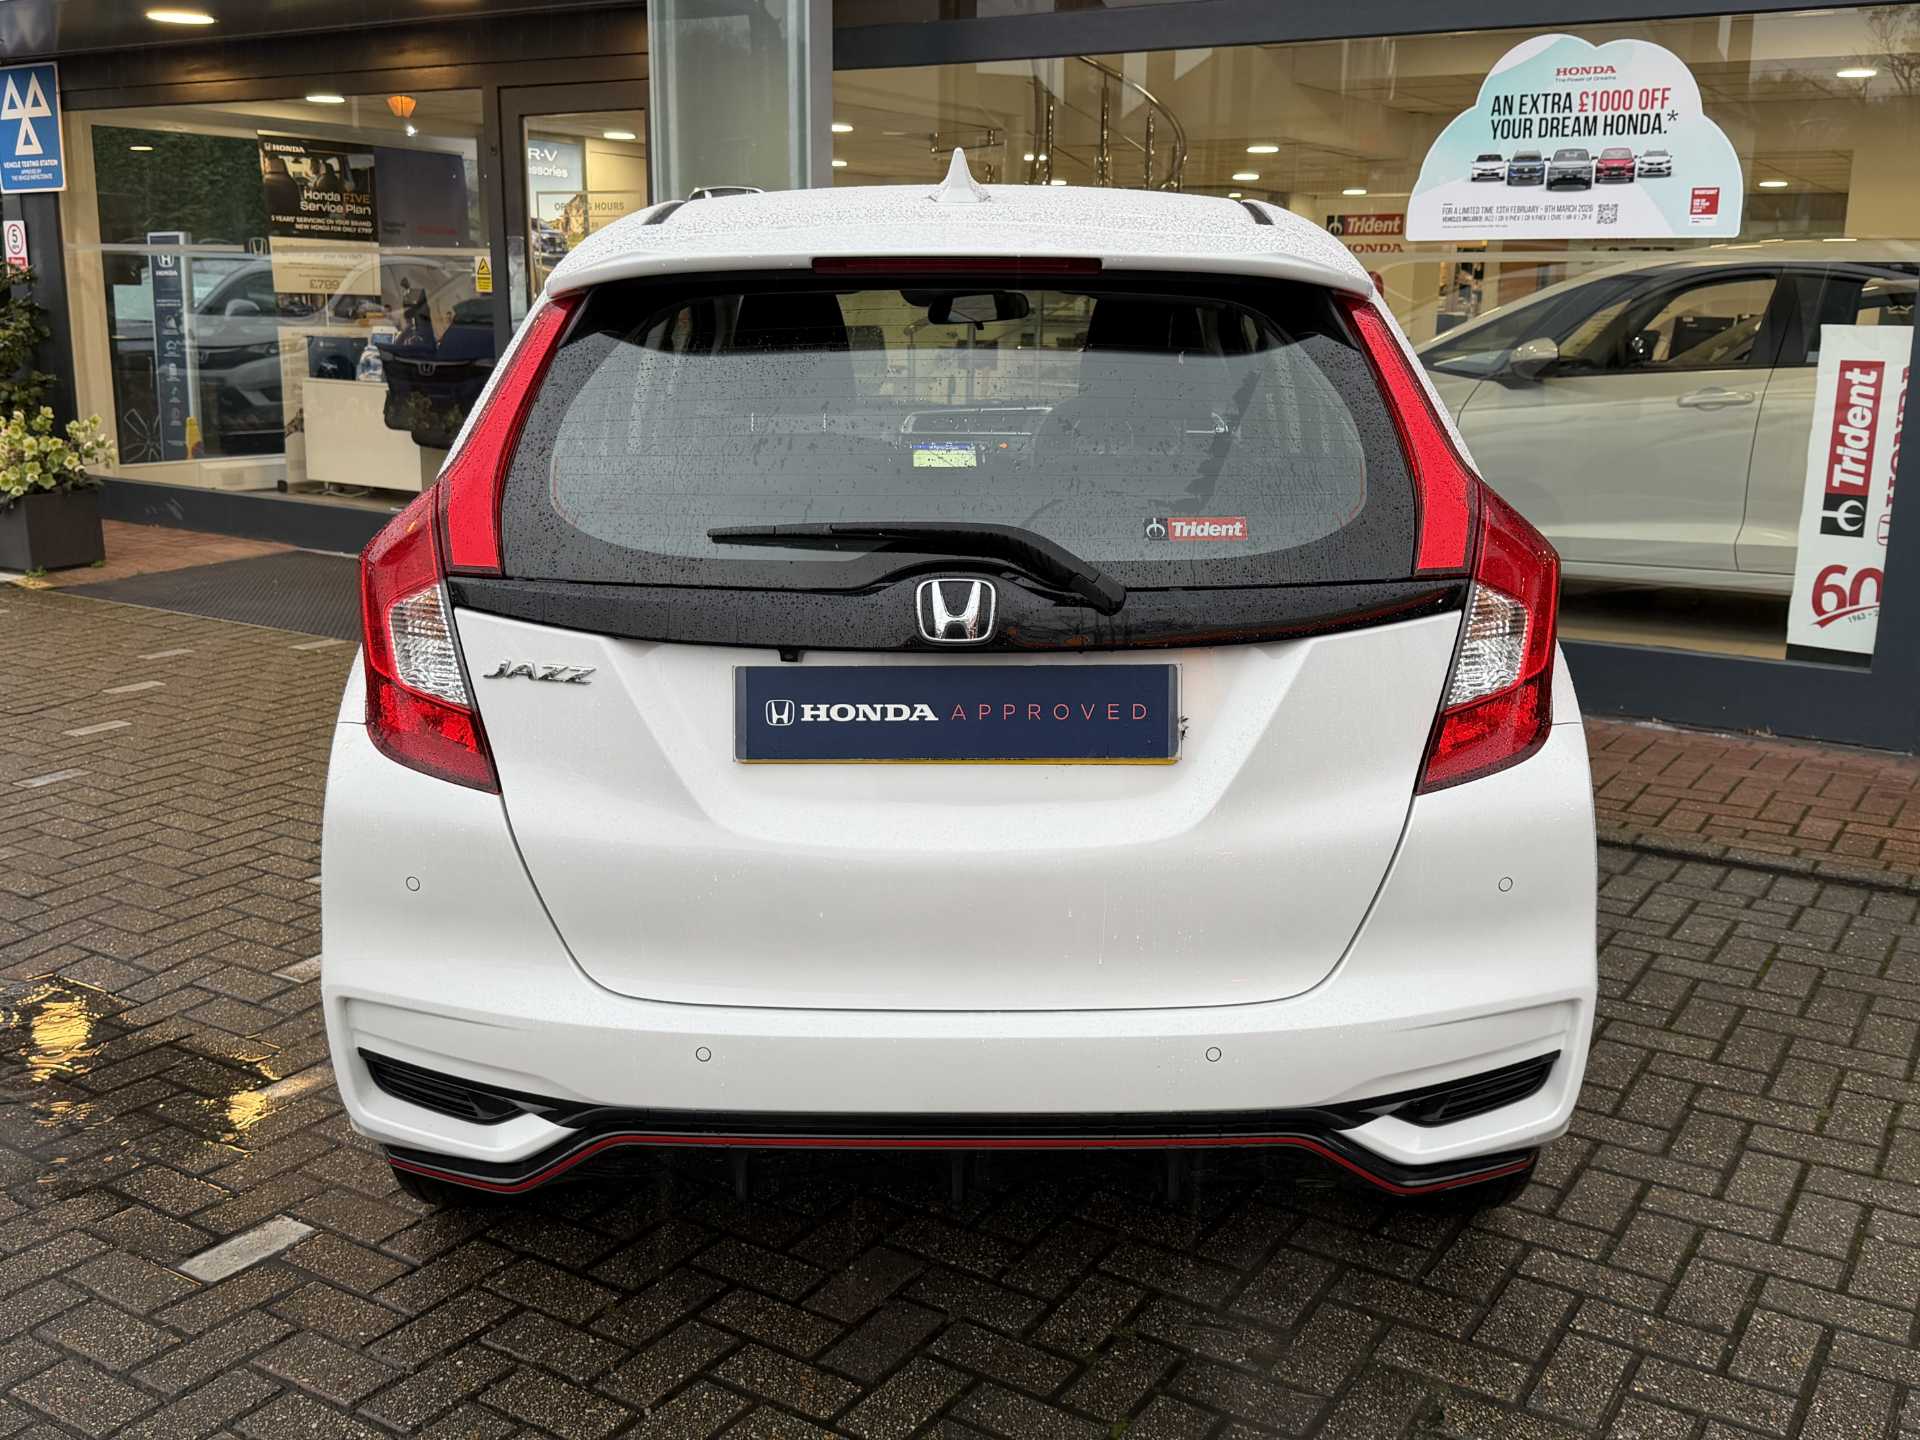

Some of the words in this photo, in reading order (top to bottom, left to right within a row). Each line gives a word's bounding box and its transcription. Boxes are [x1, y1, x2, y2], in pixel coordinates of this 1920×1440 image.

[1556, 66, 1616, 76] HONDA
[1491, 95, 1514, 116] AN
[1518, 92, 1573, 115] EXTRA
[1578, 89, 1633, 113] £1000
[1638, 88, 1671, 110] OFF
[1491, 118, 1533, 140] YOUR
[1538, 116, 1598, 138] DREAM
[272, 143, 305, 153] HONDA
[303, 188, 341, 202] Honda
[343, 193, 371, 204] FIVE
[300, 200, 343, 214] Service
[345, 204, 372, 216] Plan
[594, 202, 625, 211] HOURS
[1346, 215, 1401, 233] Trident
[12, 229, 18, 243] 5
[1832, 367, 1878, 488] Trident
[1171, 521, 1243, 537] Trident
[482, 659, 597, 686] JAZZ
[801, 703, 939, 722] HONDA
[951, 703, 1148, 721] APPROVED
